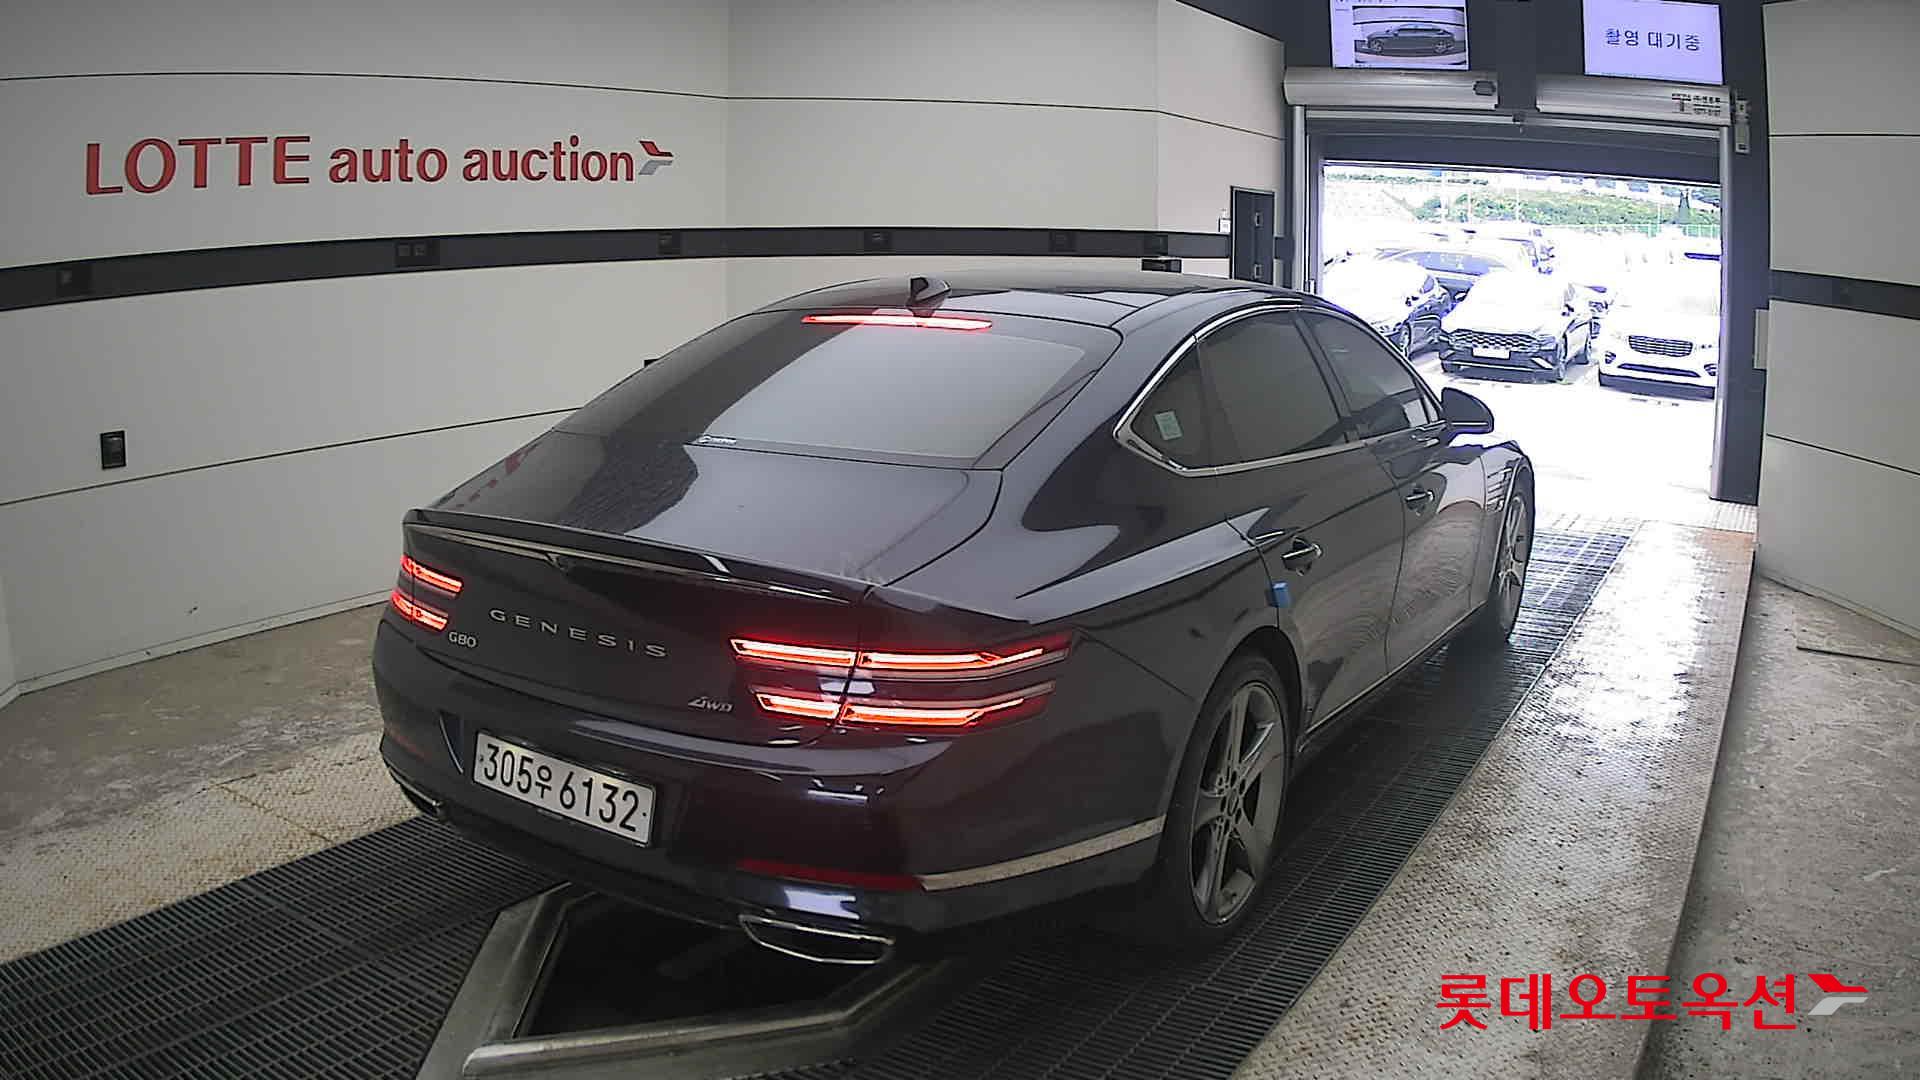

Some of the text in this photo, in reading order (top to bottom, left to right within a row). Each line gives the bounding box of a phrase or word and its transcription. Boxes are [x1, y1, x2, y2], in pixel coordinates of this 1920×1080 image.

[1647, 31, 1701, 51] 대기중
[86, 135, 635, 195] LOTTE auto auction
[448, 631, 477, 648] G80
[489, 608, 667, 657] GENESIS
[483, 743, 640, 833] 305우 6132
